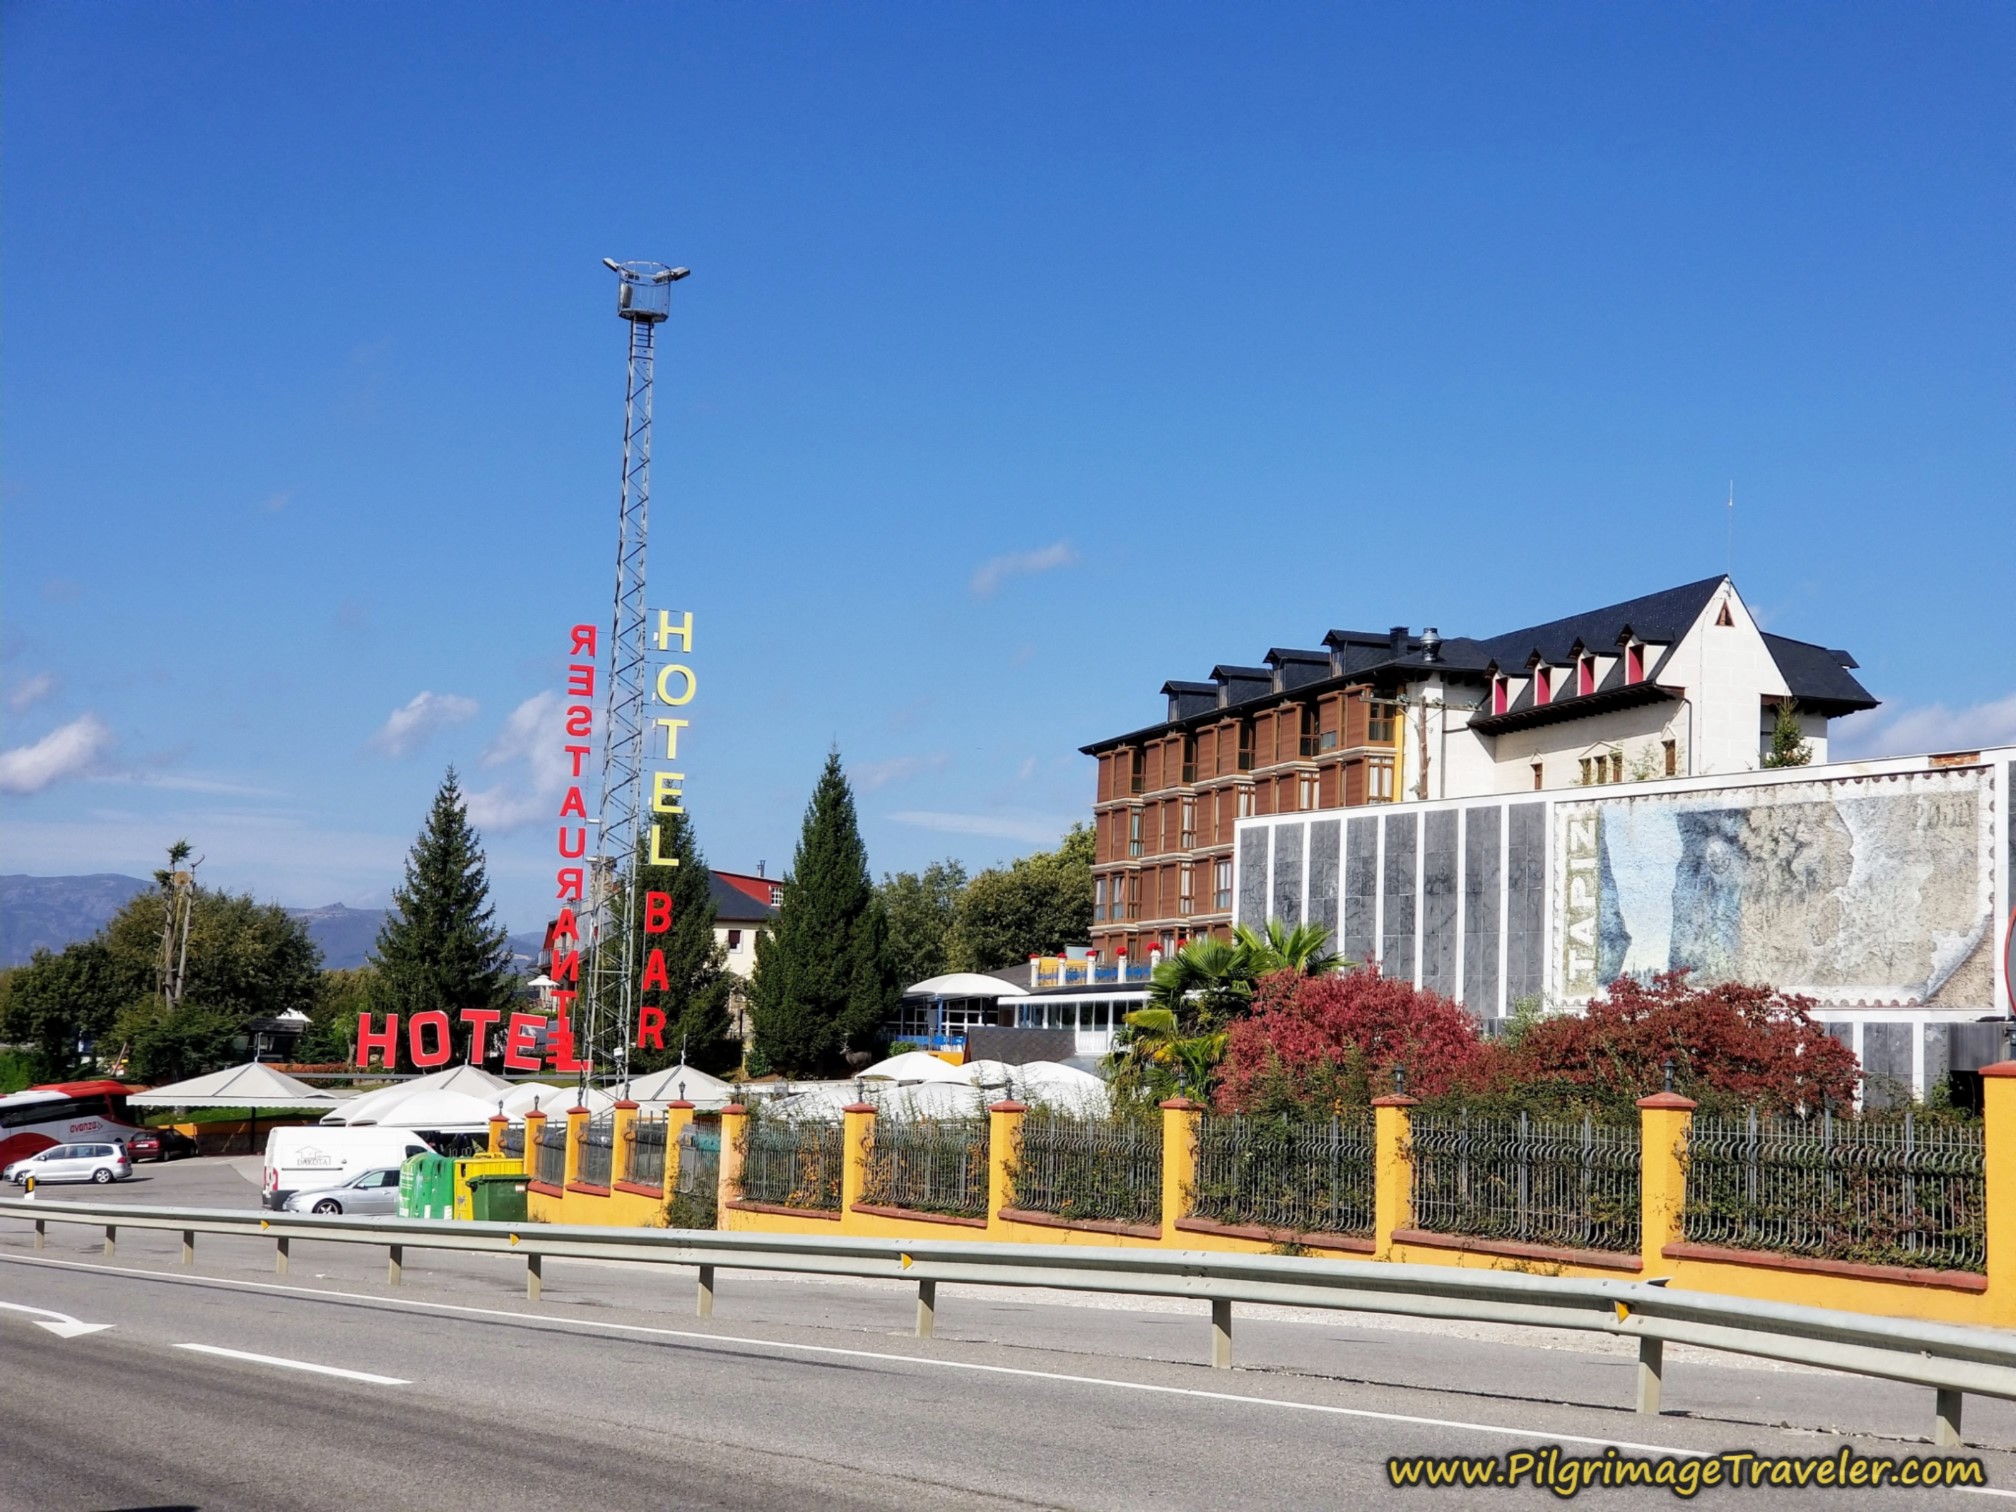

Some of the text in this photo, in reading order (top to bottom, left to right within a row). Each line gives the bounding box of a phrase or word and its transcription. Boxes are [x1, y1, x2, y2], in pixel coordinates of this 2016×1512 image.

[637, 609, 697, 1049] HOTEL BAR
[1568, 819, 1597, 981] TAPIZ
[356, 1008, 594, 1073] HOTEL
